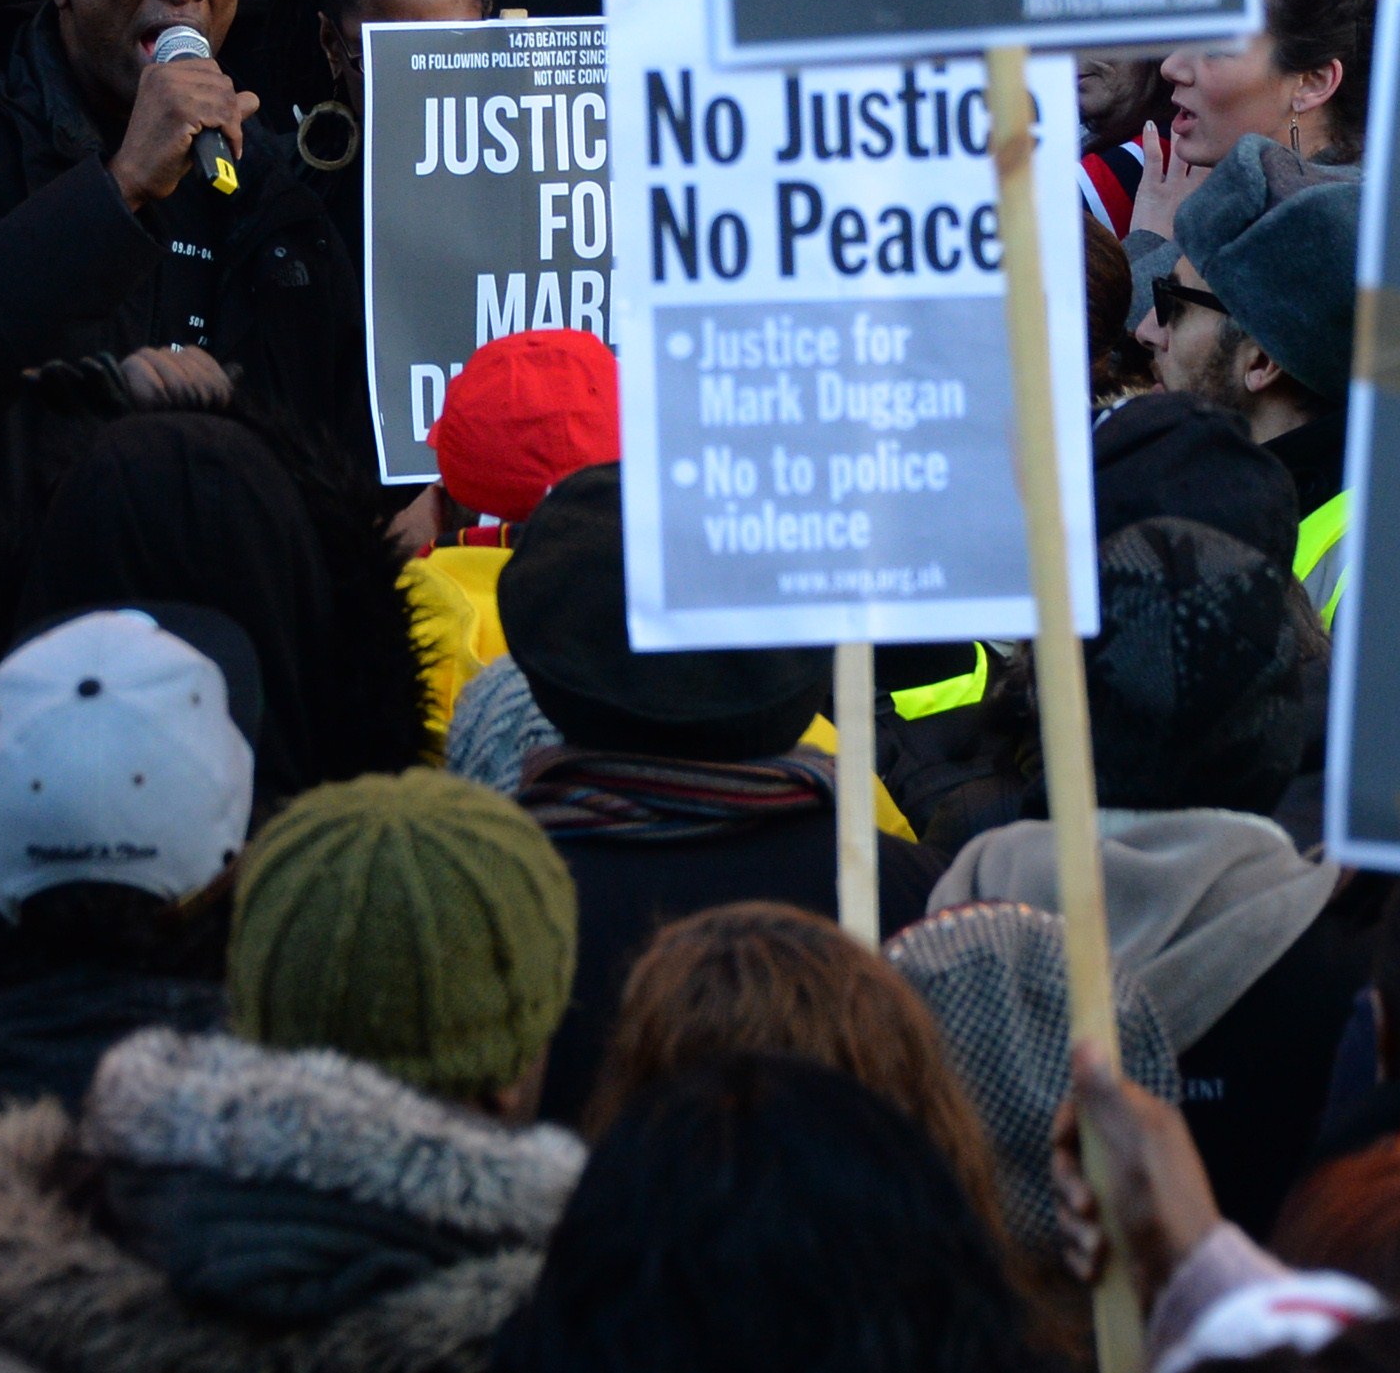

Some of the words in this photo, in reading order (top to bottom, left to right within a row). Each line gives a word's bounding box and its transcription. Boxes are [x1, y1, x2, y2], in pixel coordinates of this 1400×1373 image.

[411, 54, 426, 70] OR
[428, 52, 490, 70] FOLLOWING
[491, 51, 530, 68] POLICE
[531, 50, 577, 67] CONTACT
[509, 33, 535, 48] 1476
[536, 31, 577, 47] DEATHS
[579, 30, 592, 46] IN
[533, 69, 553, 87] NOT
[554, 69, 576, 85] ONE
[646, 67, 744, 167] No
[776, 60, 1041, 162] Justic
[539, 179, 616, 260] FO
[650, 184, 750, 282] No
[776, 179, 1003, 278] Peace
[473, 268, 618, 350] MAR
[699, 315, 840, 371] Justice
[851, 310, 912, 365] for
[701, 370, 802, 426] Mark
[815, 370, 966, 431] Duggan
[703, 445, 758, 498] No
[772, 444, 815, 495] to
[829, 439, 948, 503] police
[703, 499, 871, 554] violence
